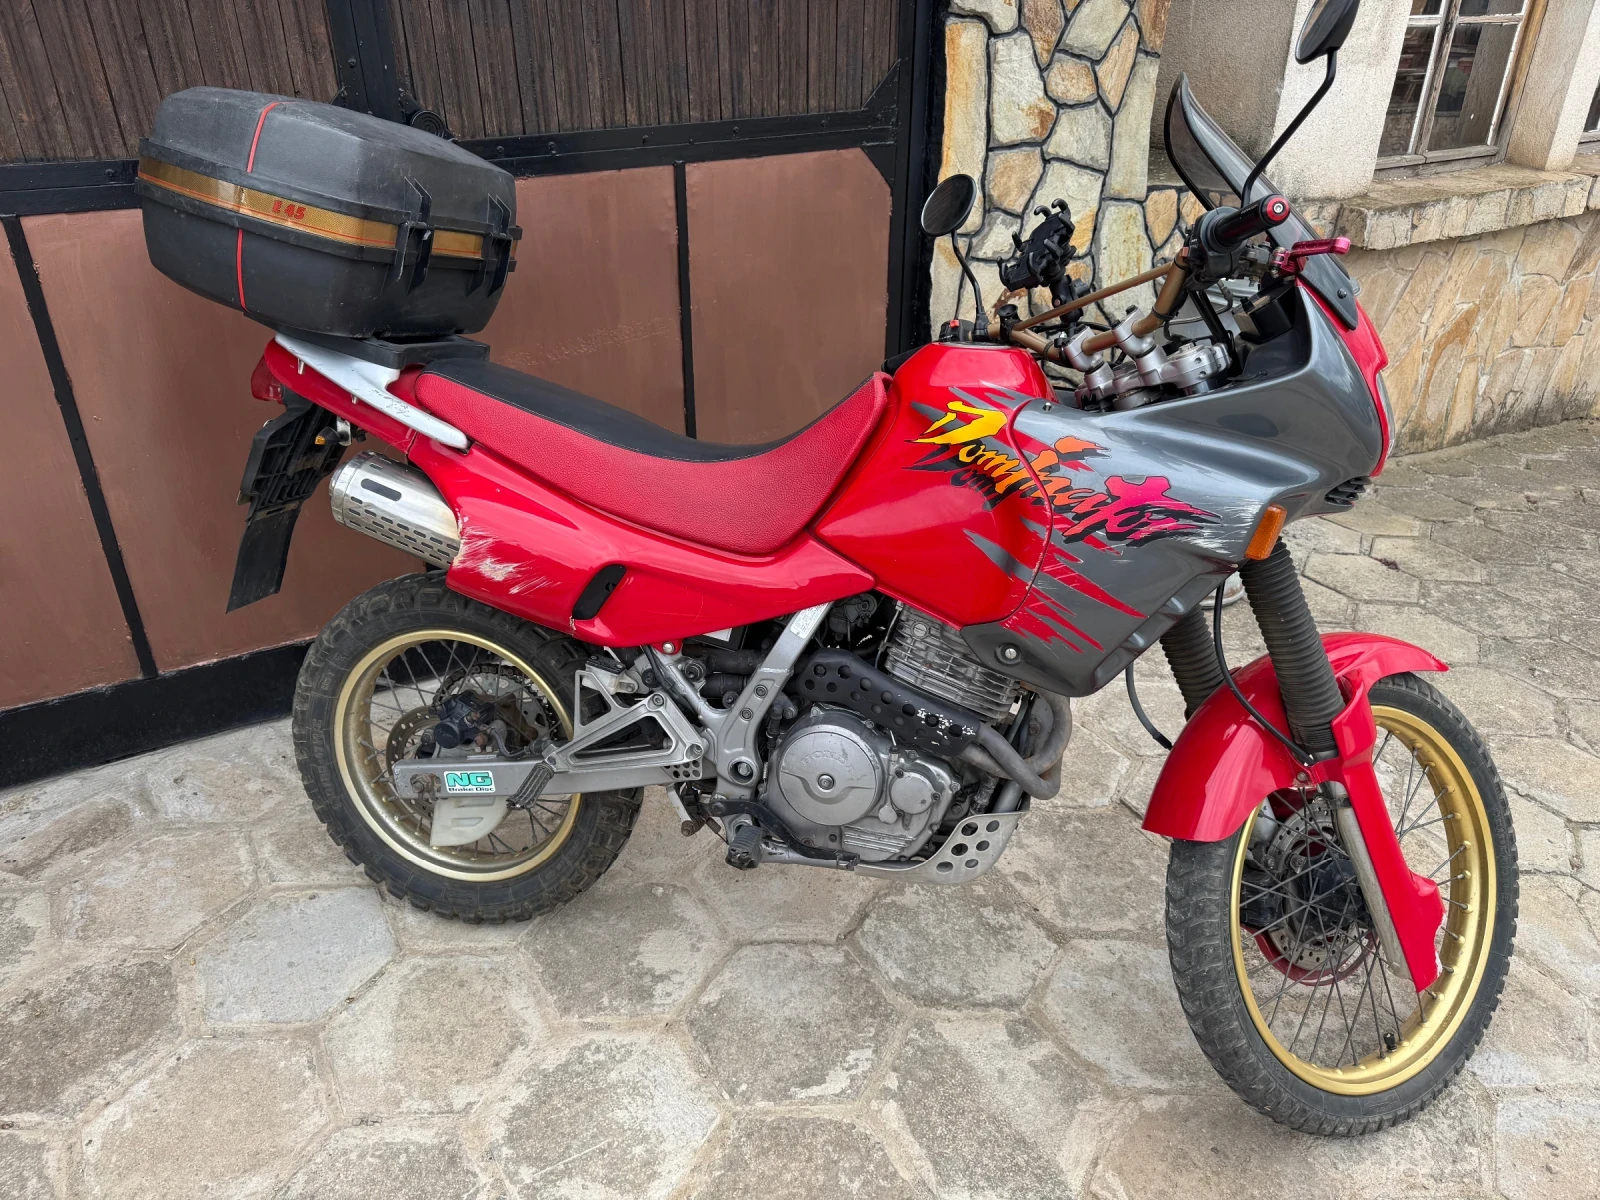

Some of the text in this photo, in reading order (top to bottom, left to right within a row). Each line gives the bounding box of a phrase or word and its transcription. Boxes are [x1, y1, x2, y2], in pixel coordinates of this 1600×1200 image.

[272, 200, 306, 219] E 45
[446, 772, 492, 787] NG
